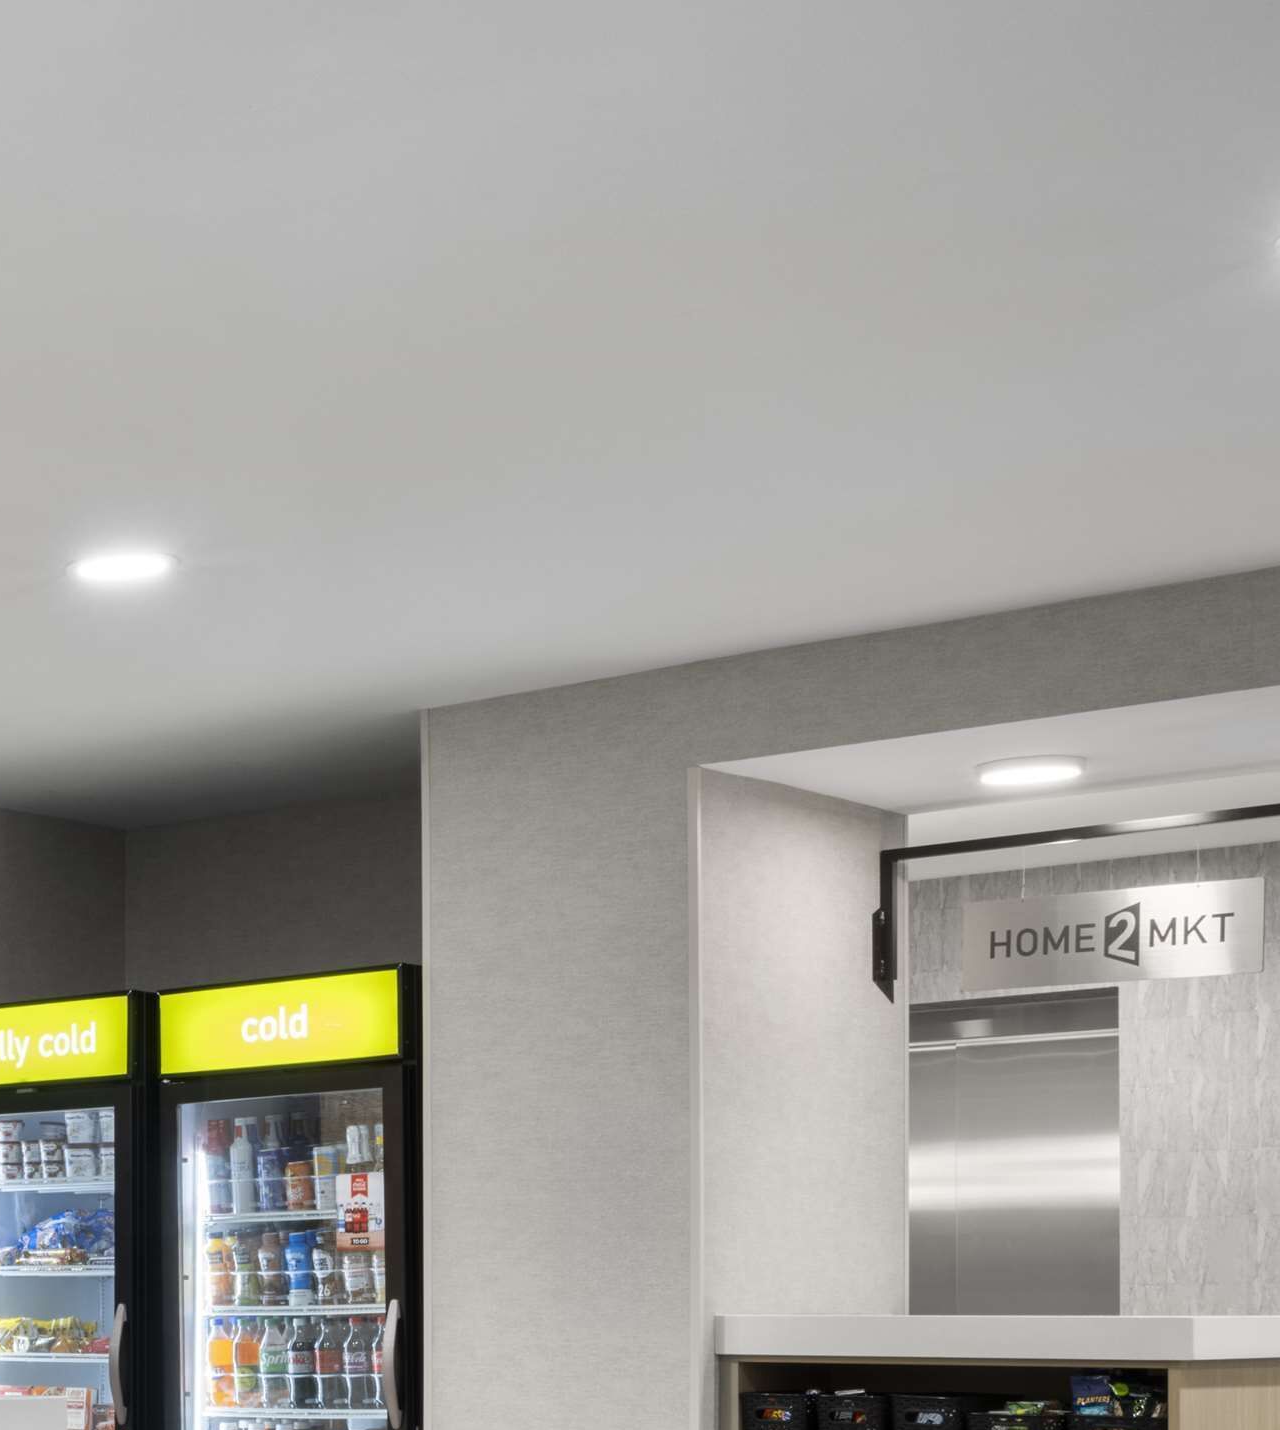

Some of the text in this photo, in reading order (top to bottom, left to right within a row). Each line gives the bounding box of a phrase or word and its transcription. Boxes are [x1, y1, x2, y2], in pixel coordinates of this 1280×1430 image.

[989, 906, 1235, 963] HOME 2 MKT
[38, 1021, 96, 1059] cold
[241, 1003, 308, 1043] cold
